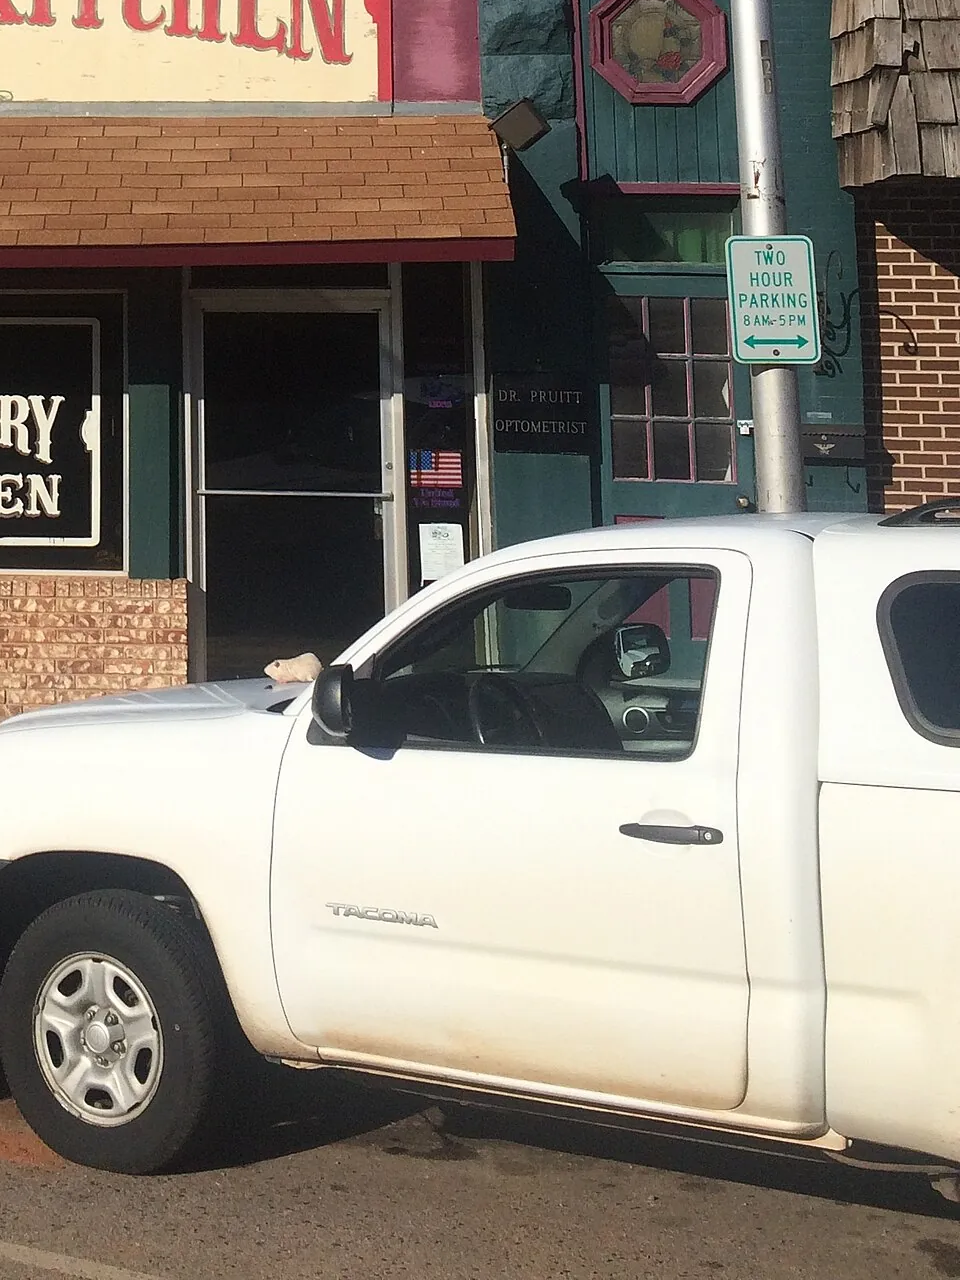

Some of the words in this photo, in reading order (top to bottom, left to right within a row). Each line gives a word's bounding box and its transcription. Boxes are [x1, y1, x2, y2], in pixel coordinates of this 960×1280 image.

[754, 250, 786, 266] TWO
[749, 272, 793, 287] HOUR
[738, 293, 808, 308] PARKING
[498, 389, 521, 402] DR.
[530, 390, 582, 404] PRUITT
[495, 419, 587, 434] OPTOMETRIST
[325, 902, 439, 929] TACOMA
